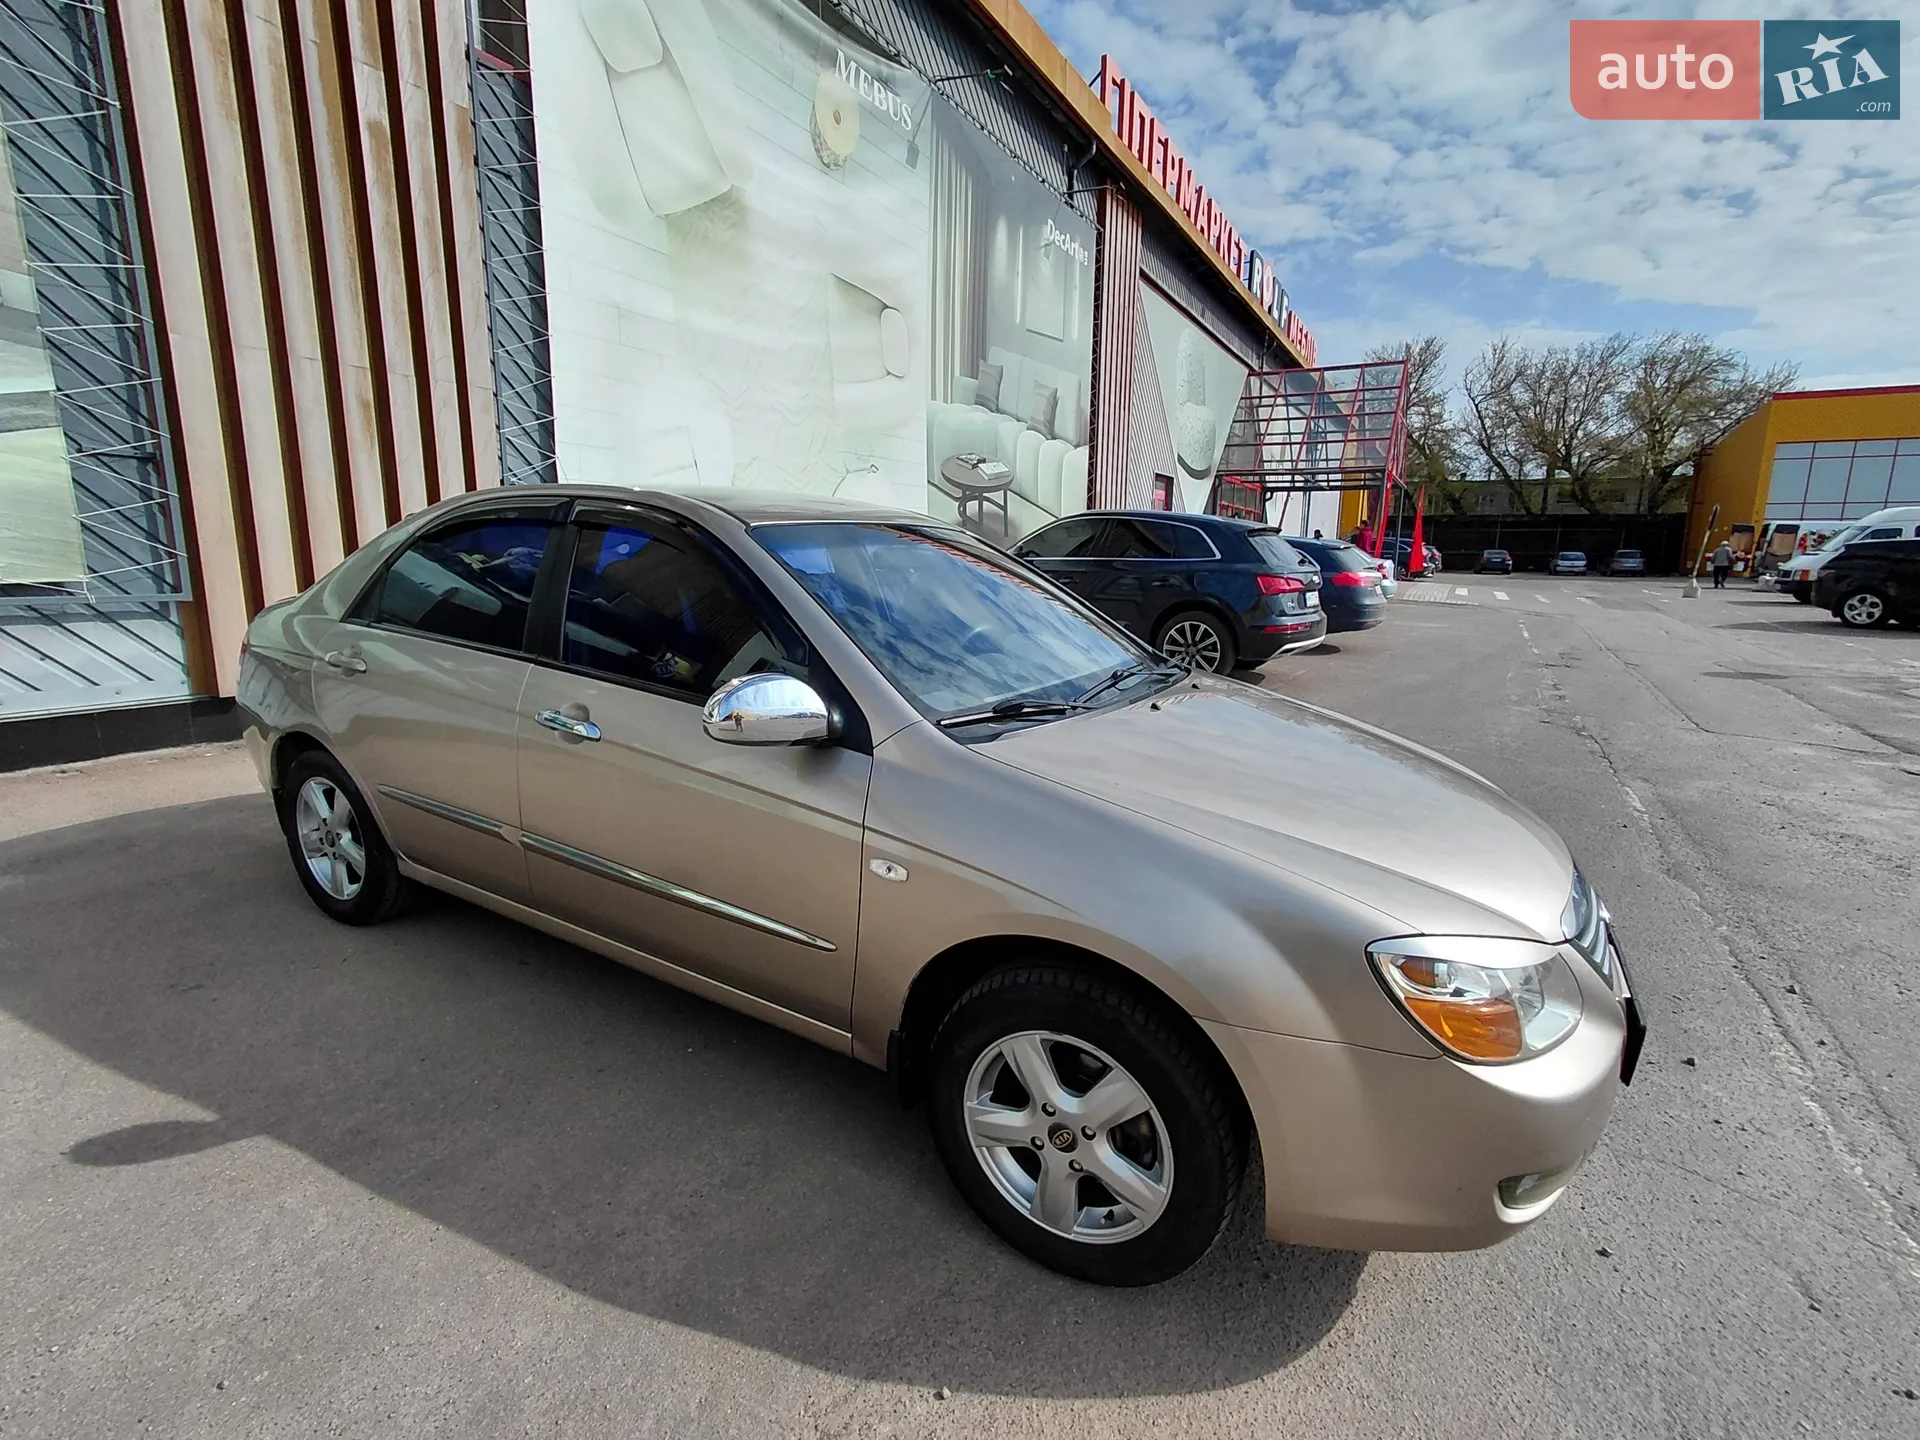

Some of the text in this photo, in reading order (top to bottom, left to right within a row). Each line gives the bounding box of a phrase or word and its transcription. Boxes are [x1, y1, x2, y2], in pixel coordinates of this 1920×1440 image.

[833, 48, 912, 131] MEBUS
[1100, 53, 1248, 283] ГІПЕРМАРКЕТ
[1055, 1132, 1071, 1145] KIA
